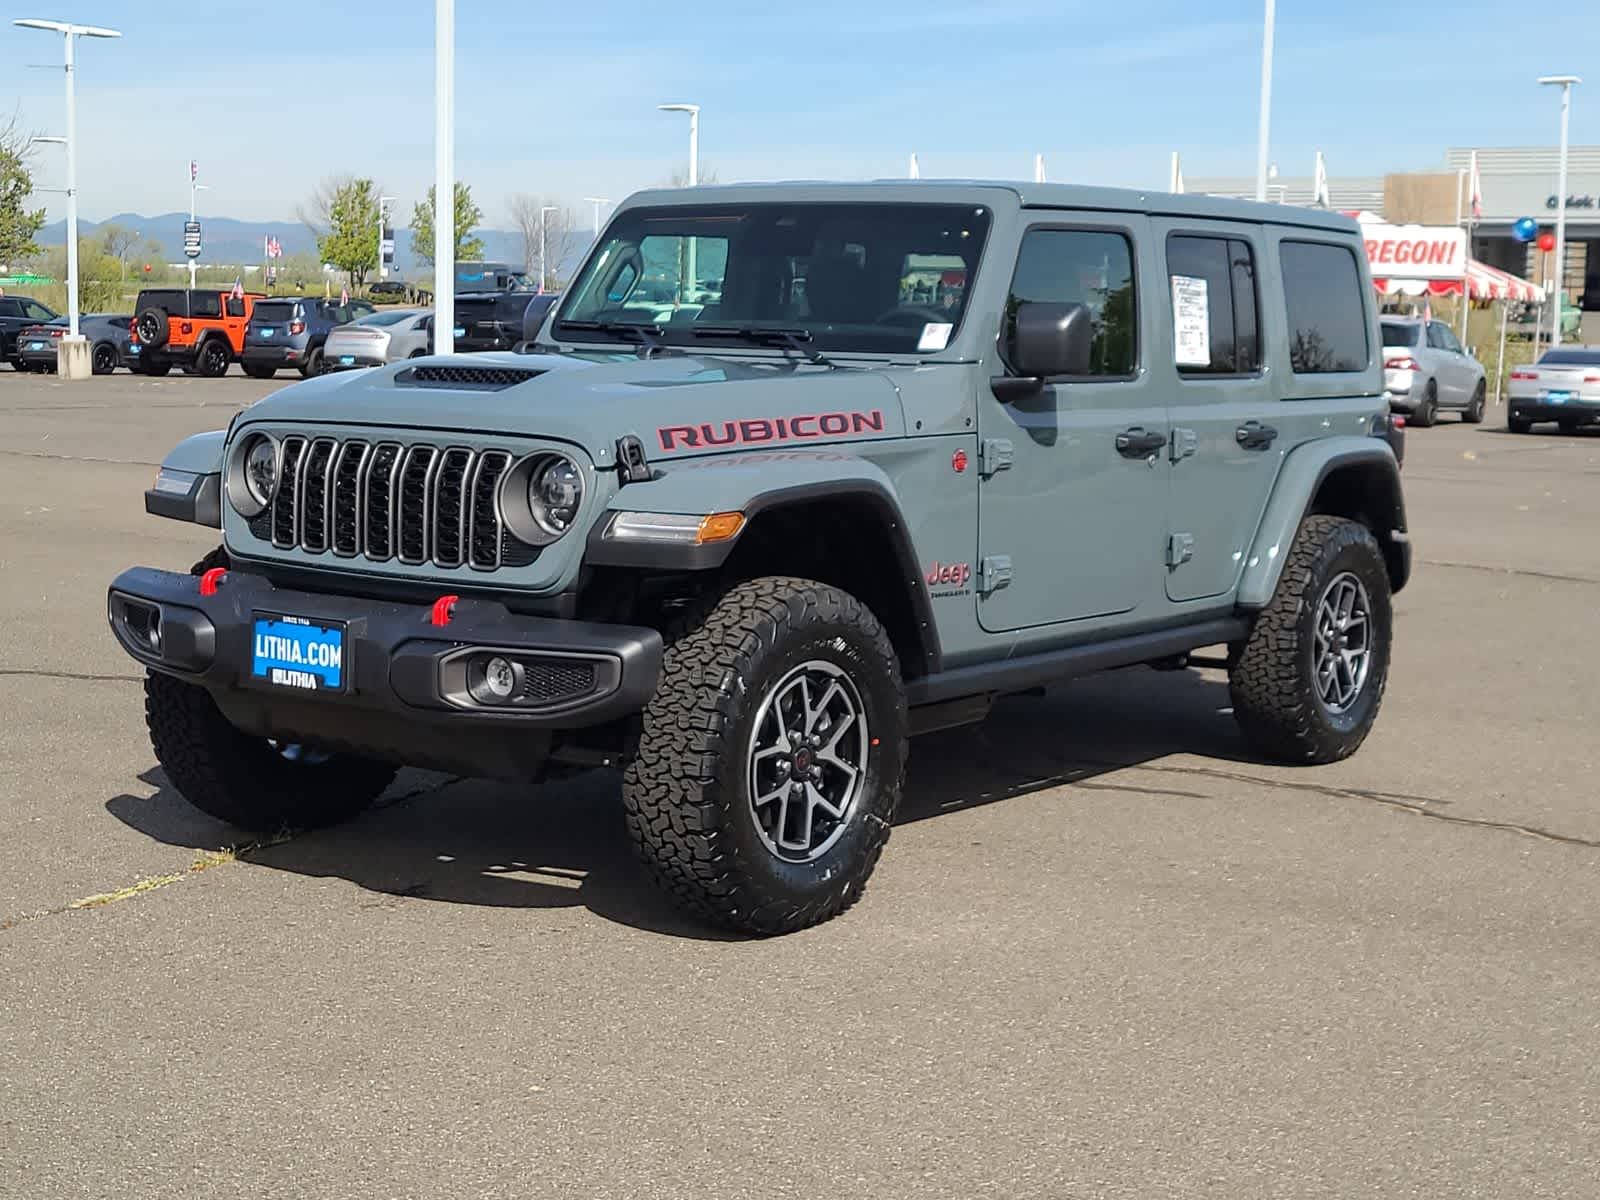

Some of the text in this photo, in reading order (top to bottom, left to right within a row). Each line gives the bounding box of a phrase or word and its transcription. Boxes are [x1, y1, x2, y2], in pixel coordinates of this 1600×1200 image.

[658, 410, 884, 451] RUBICON
[925, 560, 971, 588] Jeep
[255, 633, 342, 669] LITHIA.COM
[282, 669, 317, 690] LITHIA
